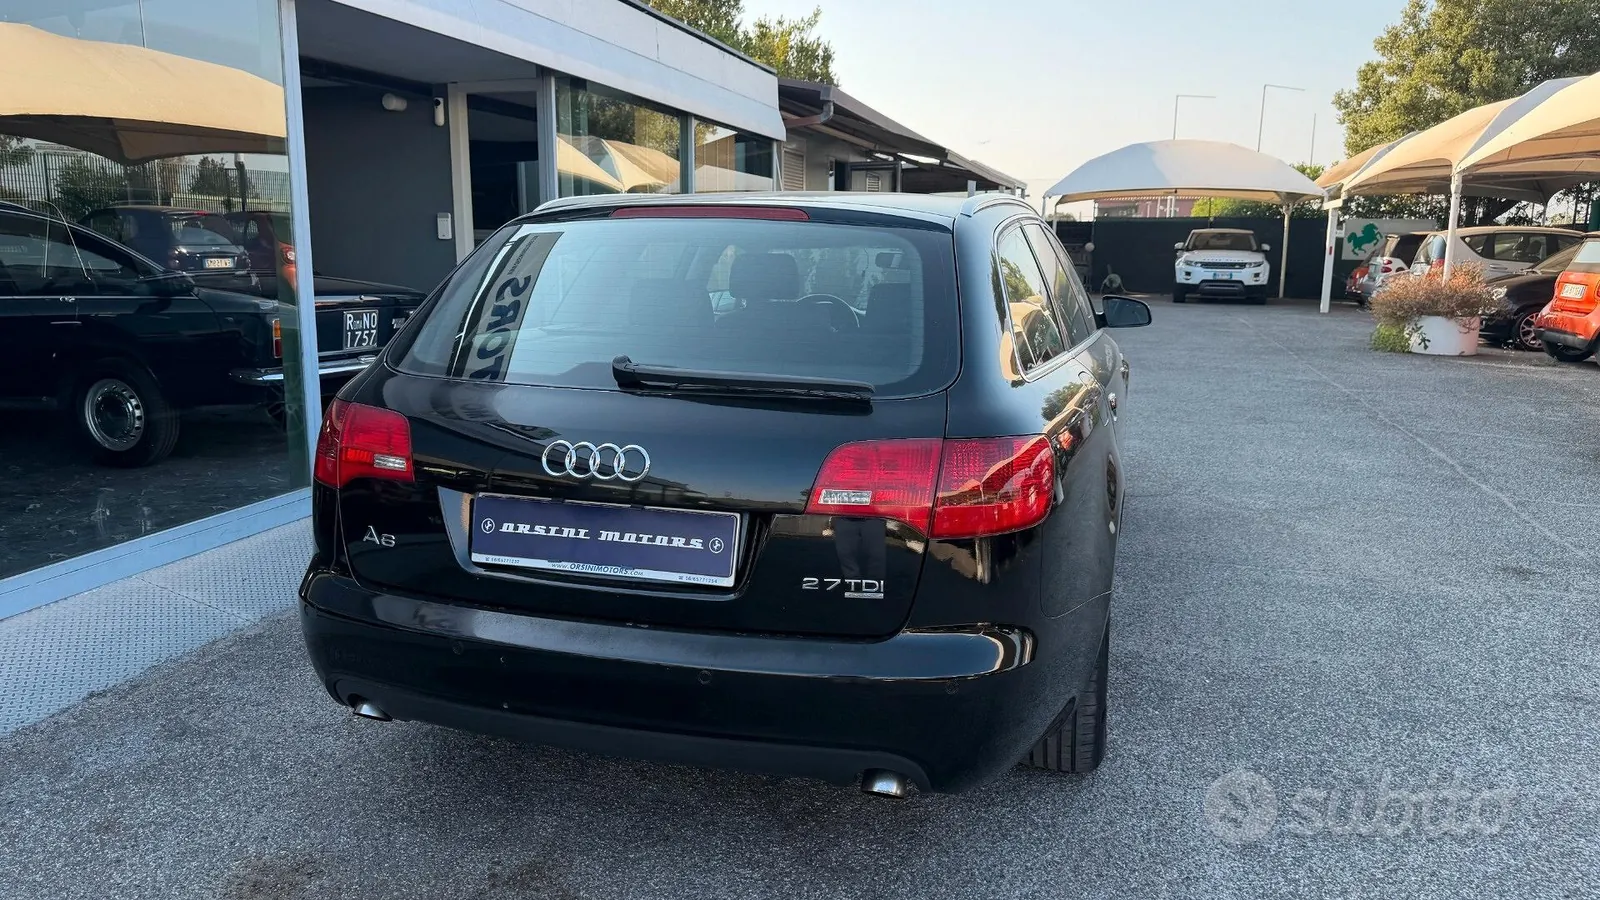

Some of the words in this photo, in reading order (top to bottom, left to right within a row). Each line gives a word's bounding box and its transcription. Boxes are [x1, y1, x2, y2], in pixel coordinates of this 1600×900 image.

[347, 330, 377, 348] 1757
[363, 525, 396, 547] A6
[499, 522, 590, 539] ORSINI
[598, 530, 704, 550] MOTORS
[844, 579, 884, 593] TDI
